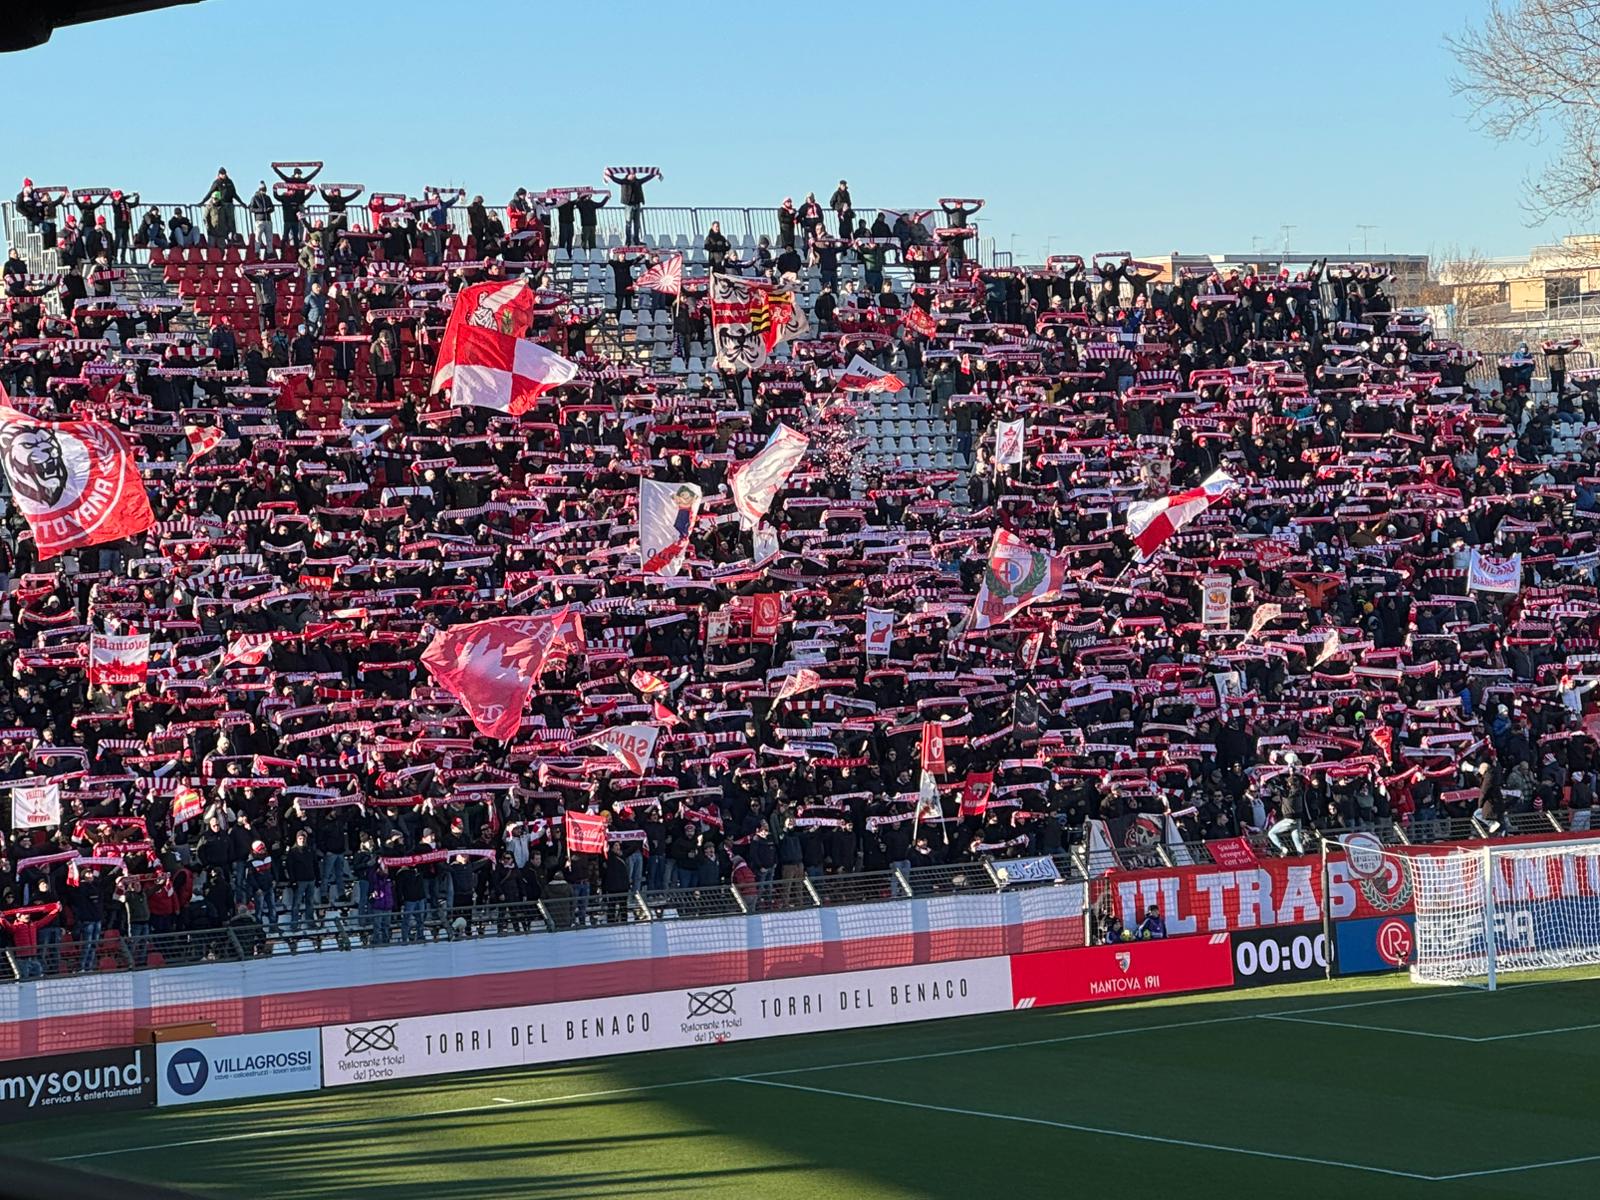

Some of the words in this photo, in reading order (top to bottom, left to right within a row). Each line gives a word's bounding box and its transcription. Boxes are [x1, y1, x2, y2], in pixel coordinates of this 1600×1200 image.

[1118, 861, 1357, 936] ULTRAS
[1236, 933, 1335, 976] 00:00
[1089, 977, 1140, 995] MANTOVA
[1144, 975, 1161, 988] 1911
[760, 993, 822, 1019] TORRI
[840, 988, 874, 1011] DEL
[890, 978, 968, 1006] BENACO
[426, 1028, 492, 1056] TORRI
[511, 1023, 548, 1047] DEL
[566, 1012, 650, 1041] BENACO
[680, 1021, 720, 1034] Ristorante
[721, 1017, 743, 1029] Hotel
[694, 1032, 707, 1043] del
[214, 1050, 312, 1074] VILLAGROSSI
[338, 1058, 380, 1072] Ristorante
[381, 1054, 406, 1067] Hotel
[353, 1069, 368, 1081] del
[368, 1067, 394, 1080] Porto
[41, 1094, 72, 1106] service
[73, 1091, 82, 1102] &
[83, 1086, 142, 1102] entertainment
